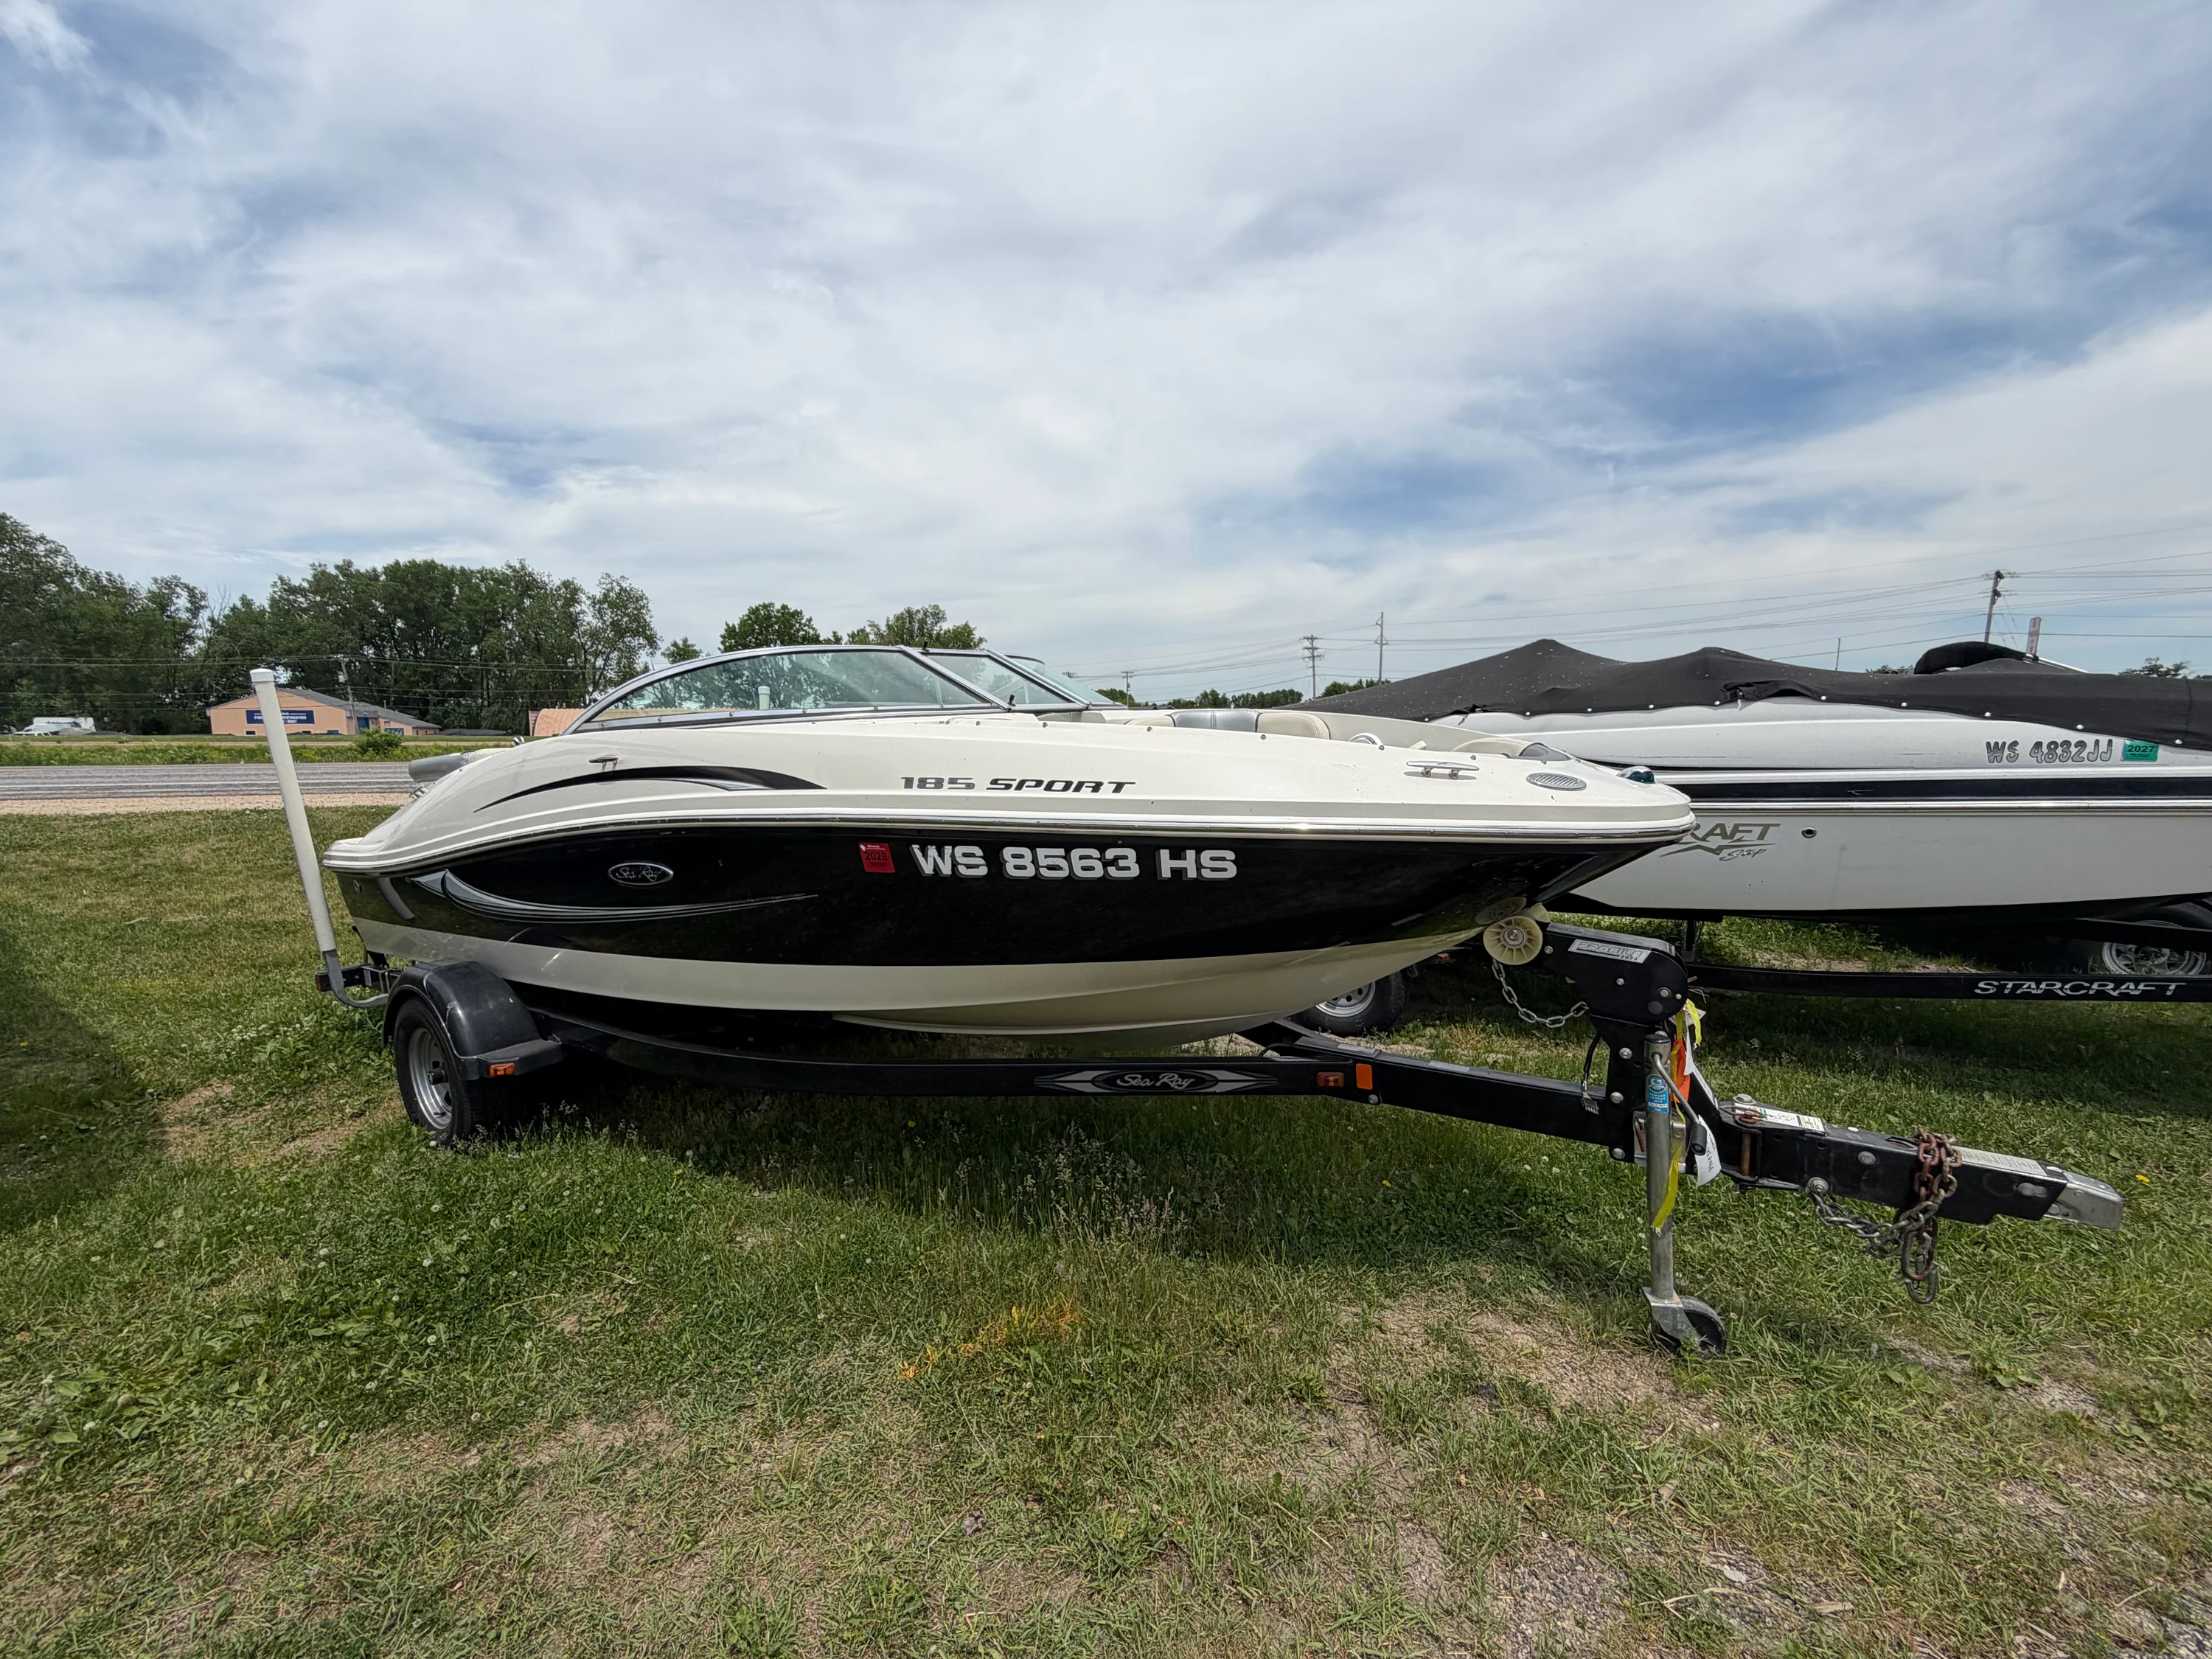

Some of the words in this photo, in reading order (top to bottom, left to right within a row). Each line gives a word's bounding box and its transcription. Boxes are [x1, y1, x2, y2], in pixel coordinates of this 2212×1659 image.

[1986, 740, 2020, 763] WS
[2029, 739, 2113, 763] 4832JJ
[2127, 745, 2156, 753] 2027
[900, 776, 976, 790] 185
[986, 778, 1136, 794] SPORT
[865, 852, 888, 861] 2028
[909, 844, 988, 877] WS
[1000, 846, 1140, 880] 8563
[1157, 849, 1237, 880] HS
[616, 867, 636, 879] Sea
[638, 866, 662, 882] Ray
[1576, 942, 1644, 958] PROFILE
[1974, 981, 2187, 996] STARCRAFT
[1116, 1074, 1155, 1087] Sea
[1155, 1073, 1194, 1089] Ray
